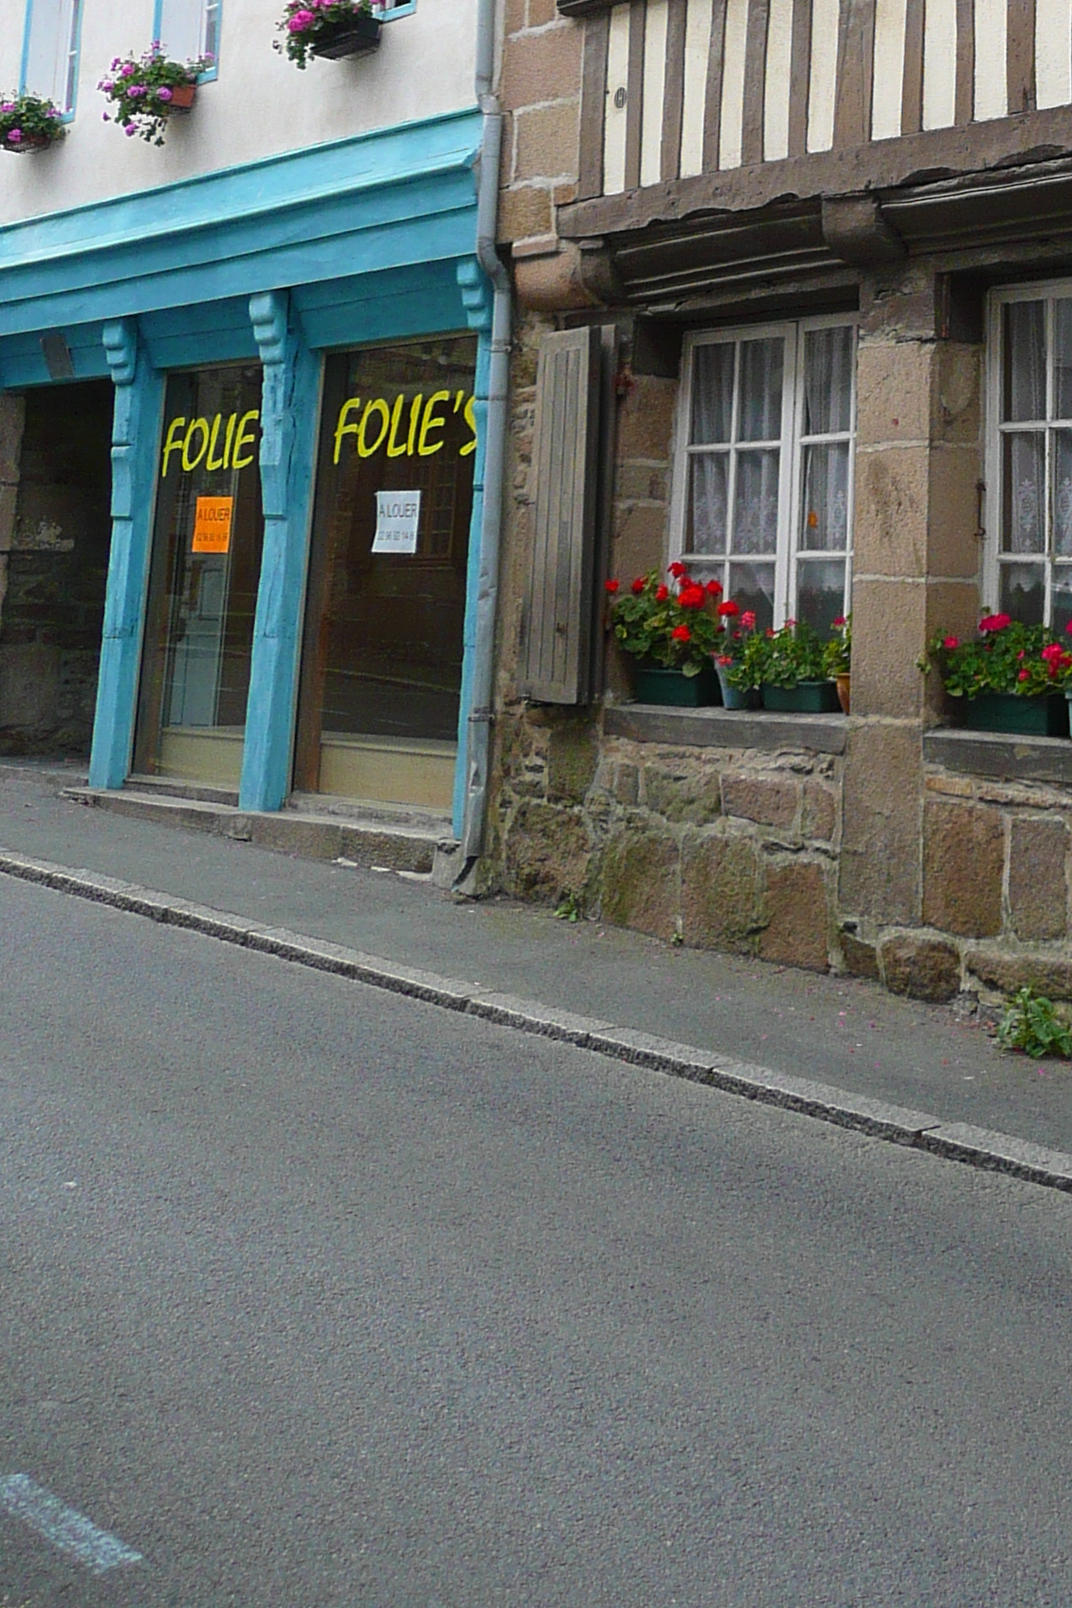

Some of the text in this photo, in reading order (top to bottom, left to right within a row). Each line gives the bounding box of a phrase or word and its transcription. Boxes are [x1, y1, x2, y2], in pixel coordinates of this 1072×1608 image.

[161, 409, 260, 478] FOLIE
[204, 507, 230, 521] LOUER
[379, 503, 417, 518] A LOUER
